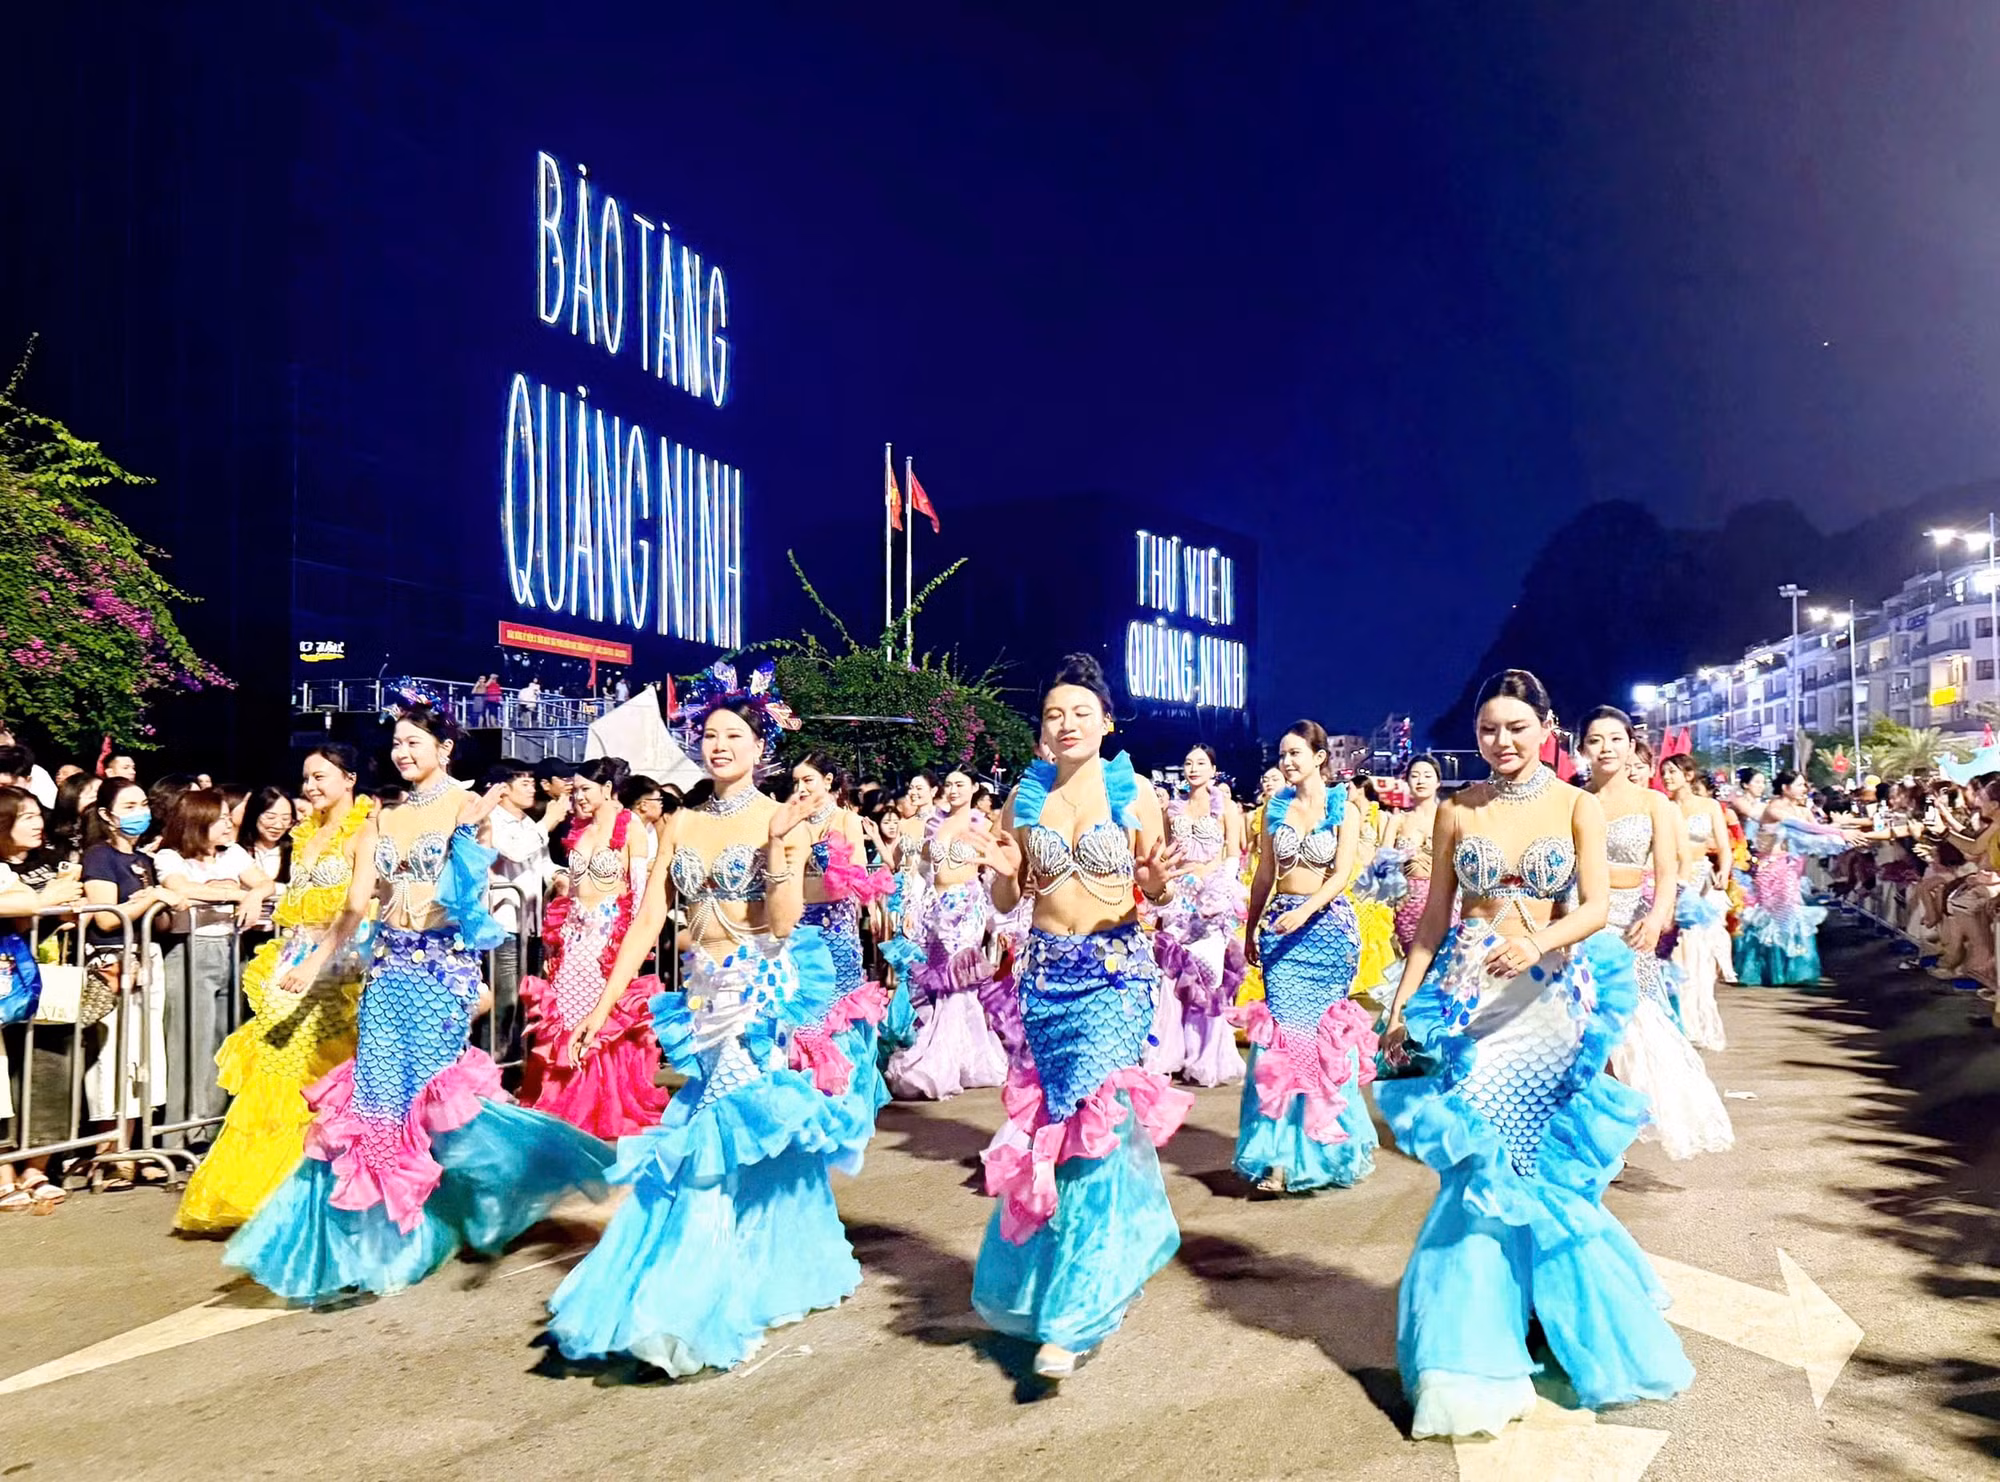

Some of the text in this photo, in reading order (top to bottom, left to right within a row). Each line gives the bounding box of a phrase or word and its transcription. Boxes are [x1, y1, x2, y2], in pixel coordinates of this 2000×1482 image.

[538, 150, 727, 407] BẢO TÀNG
[505, 372, 742, 651] QUẢNG NINH
[1196, 635, 1246, 709] NINH
